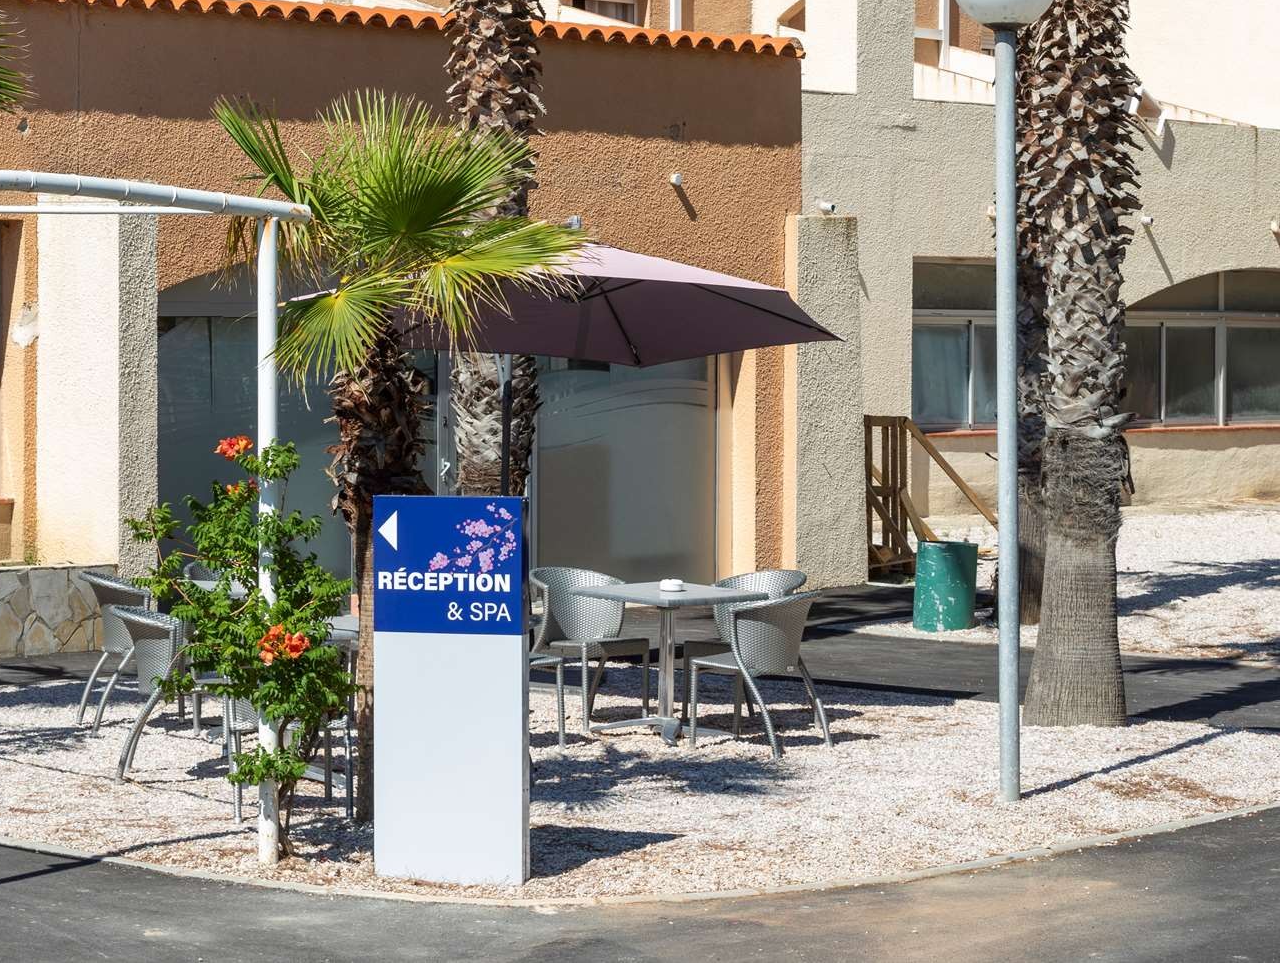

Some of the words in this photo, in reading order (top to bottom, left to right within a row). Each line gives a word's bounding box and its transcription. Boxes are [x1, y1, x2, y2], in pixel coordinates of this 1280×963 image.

[378, 567, 511, 592] RÉCEPTION
[447, 601, 464, 621] &
[469, 602, 512, 622] SPA
